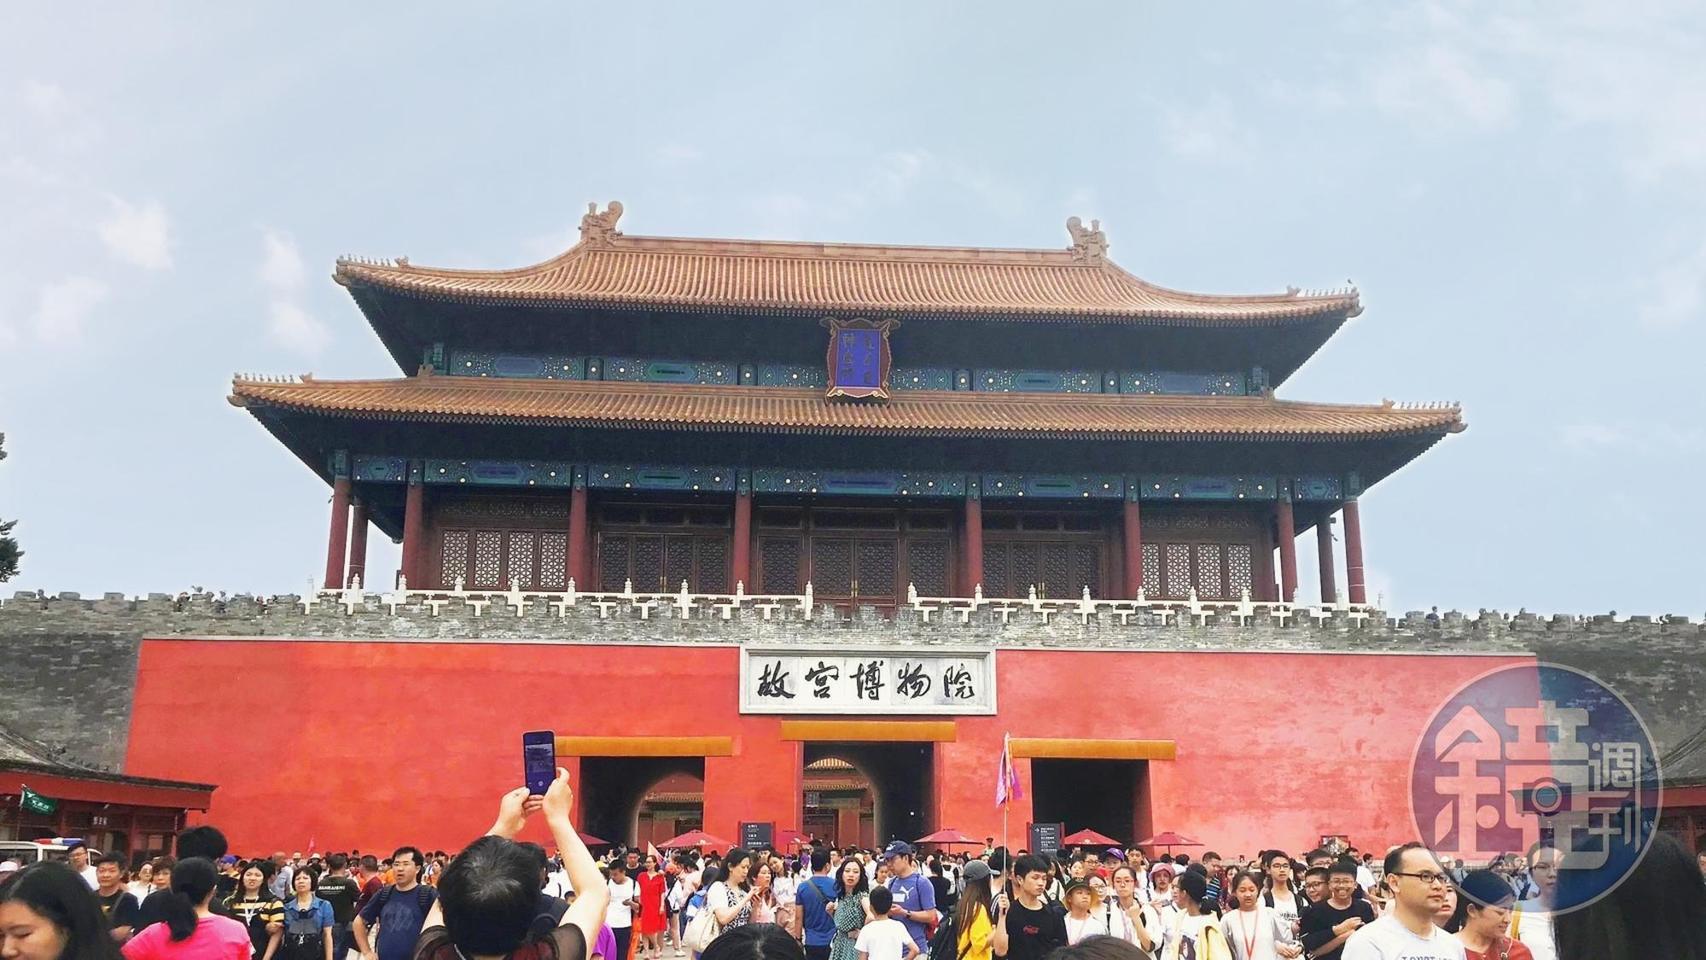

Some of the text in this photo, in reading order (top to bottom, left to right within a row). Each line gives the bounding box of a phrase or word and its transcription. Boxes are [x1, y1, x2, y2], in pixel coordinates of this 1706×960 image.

[757, 660, 976, 701] 故宫博物院
